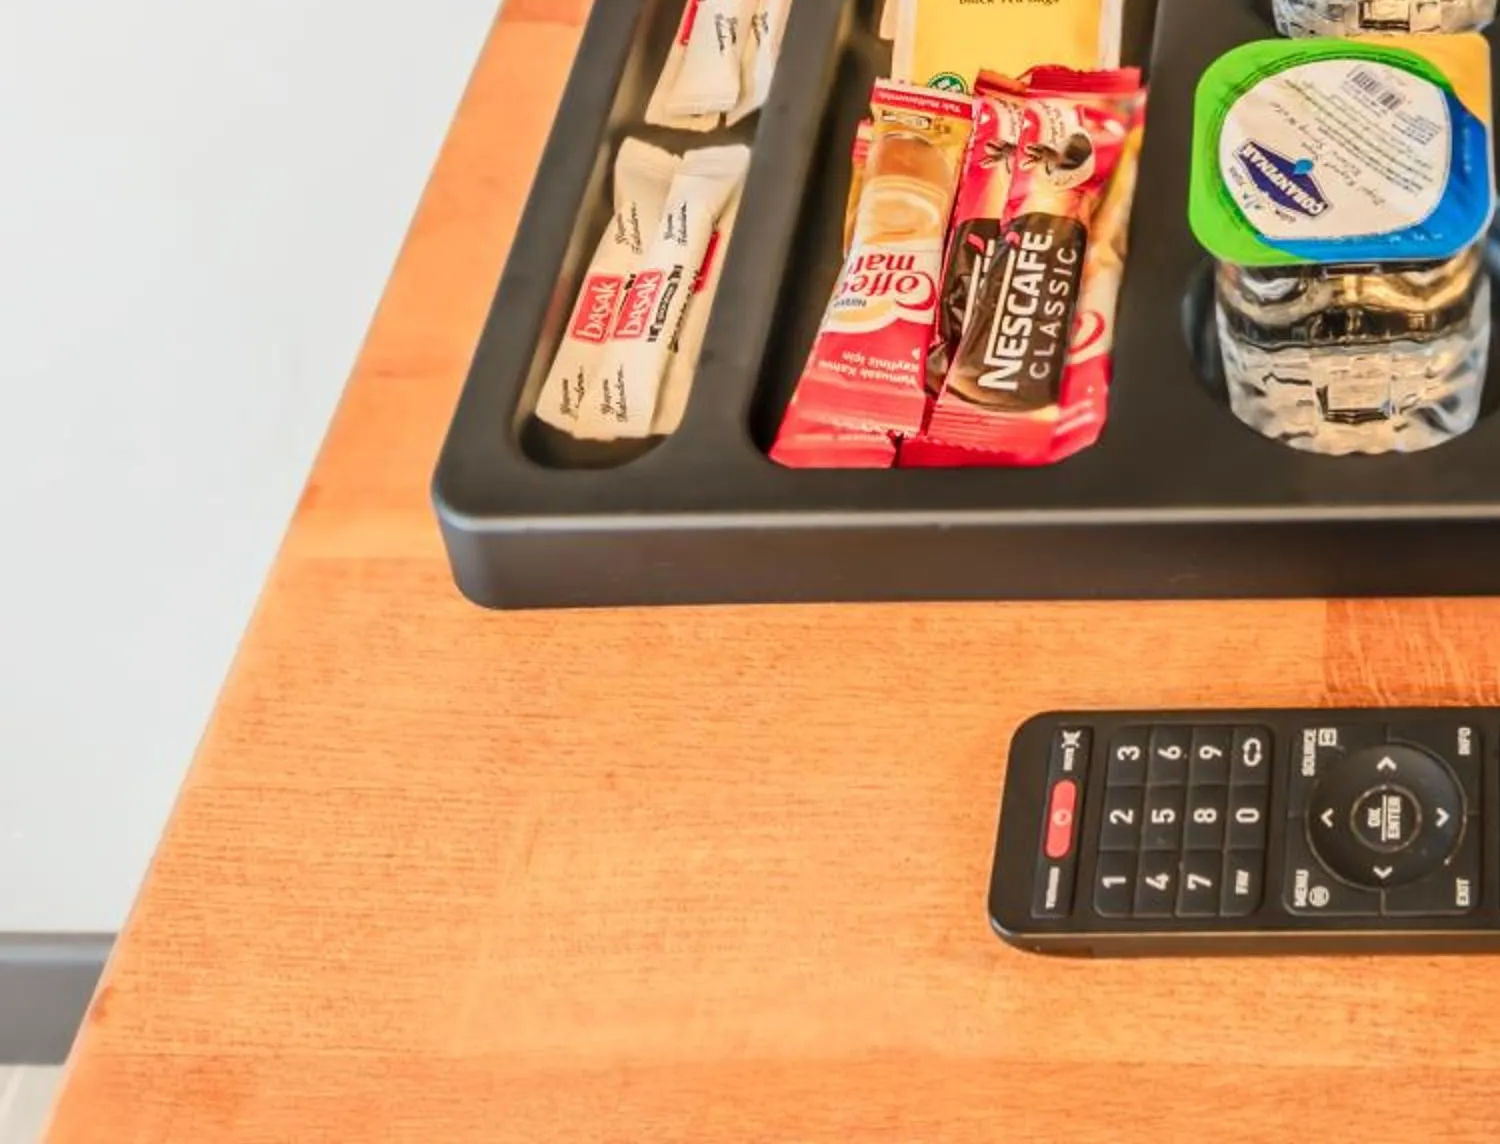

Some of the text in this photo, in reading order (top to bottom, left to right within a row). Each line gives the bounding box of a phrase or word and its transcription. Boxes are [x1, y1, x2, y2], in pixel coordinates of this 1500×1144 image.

[1029, 247, 1078, 379] CLASSIC
[1116, 745, 1141, 761] 3
[1157, 745, 1182, 761] 6
[1198, 744, 1223, 760] 9
[1108, 808, 1135, 825] 2
[1150, 807, 1176, 824] 5
[1192, 807, 1218, 824] 8
[1234, 807, 1260, 824] 0
[1387, 795, 1402, 840] ENTER
[1101, 875, 1127, 889] 1
[1144, 872, 1170, 891] 4
[1186, 873, 1213, 891] 7
[1293, 868, 1310, 908] MENU
[1455, 877, 1471, 907] EXIT
